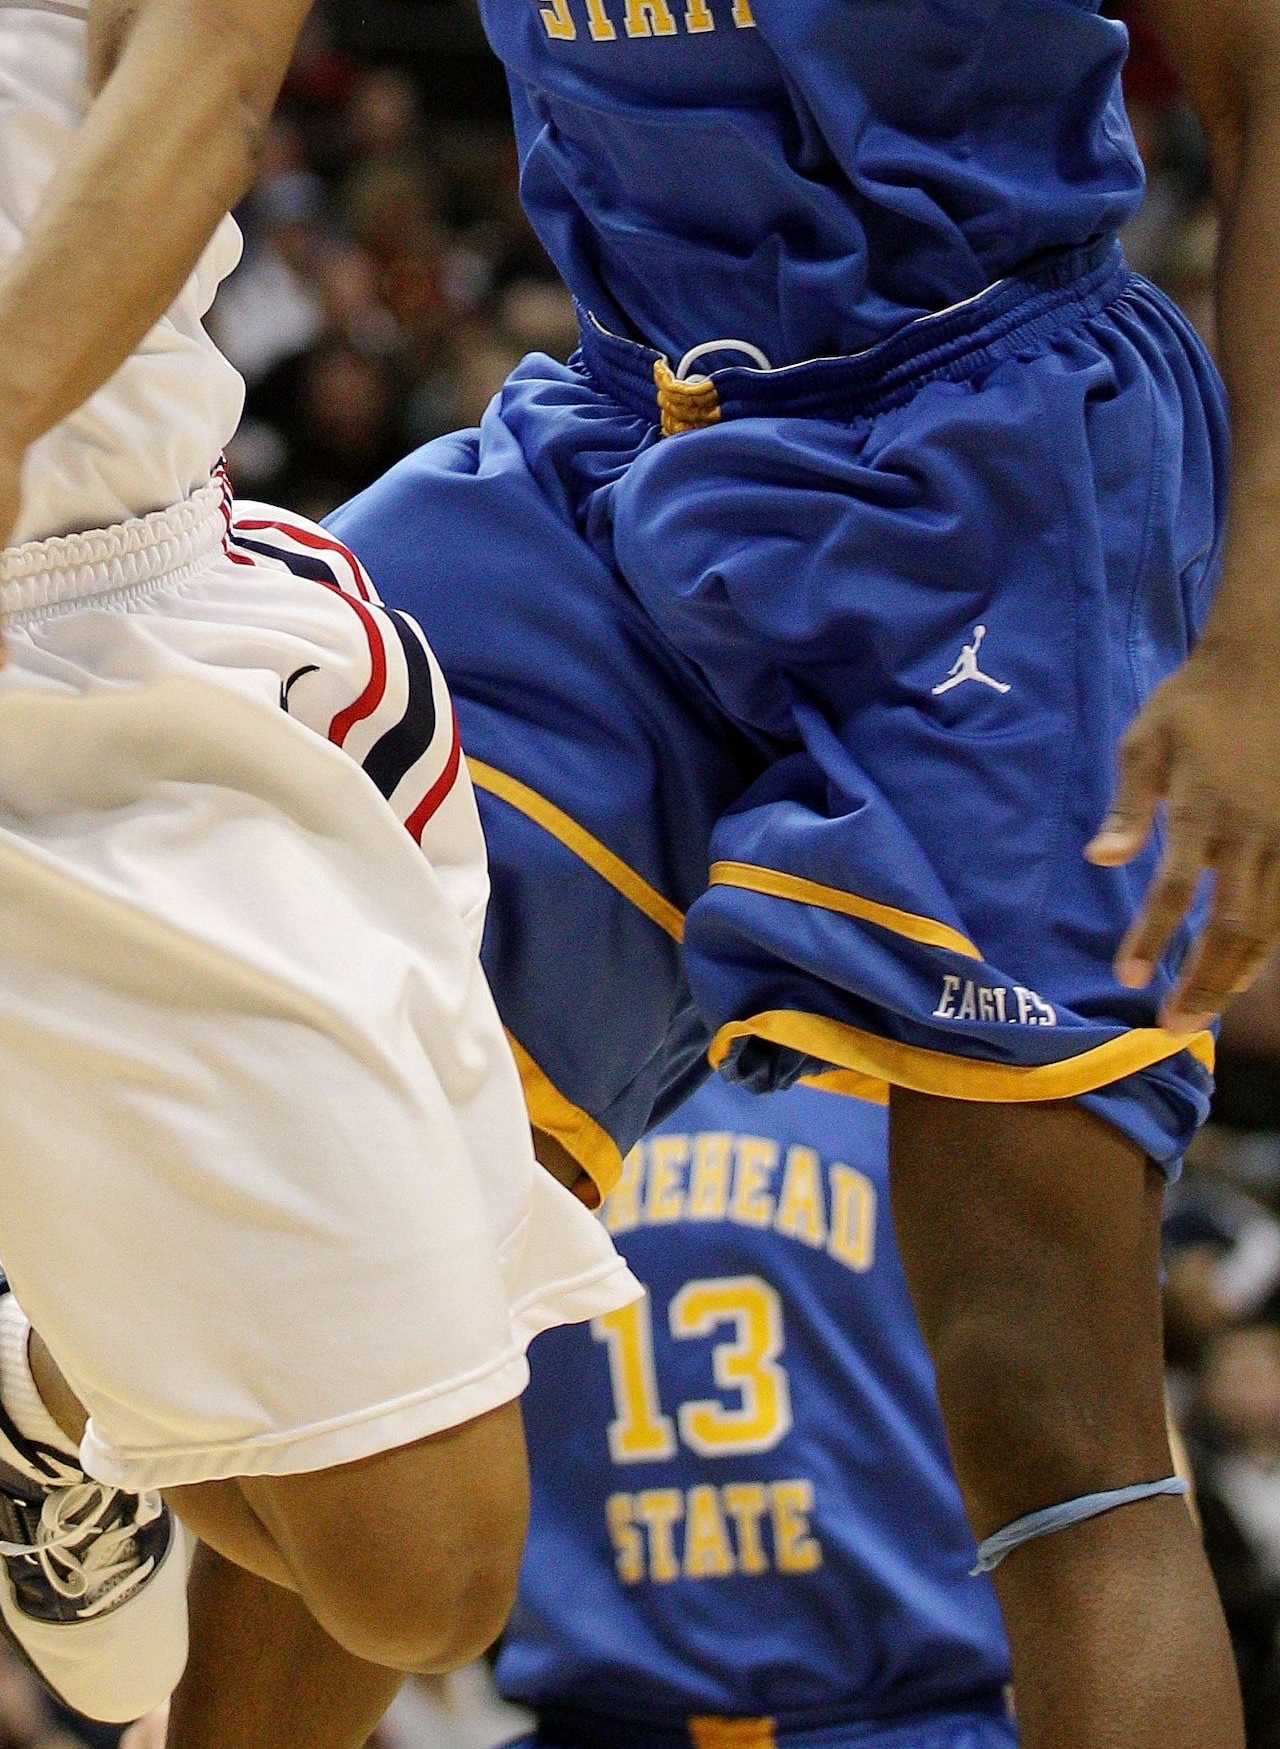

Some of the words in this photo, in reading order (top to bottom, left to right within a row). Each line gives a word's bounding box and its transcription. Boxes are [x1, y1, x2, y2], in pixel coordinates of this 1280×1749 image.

[932, 974, 1057, 1027] EAGLES
[600, 1131, 878, 1273] REHEAD
[591, 1276, 793, 1466] 13
[607, 1479, 821, 1586] STATE
